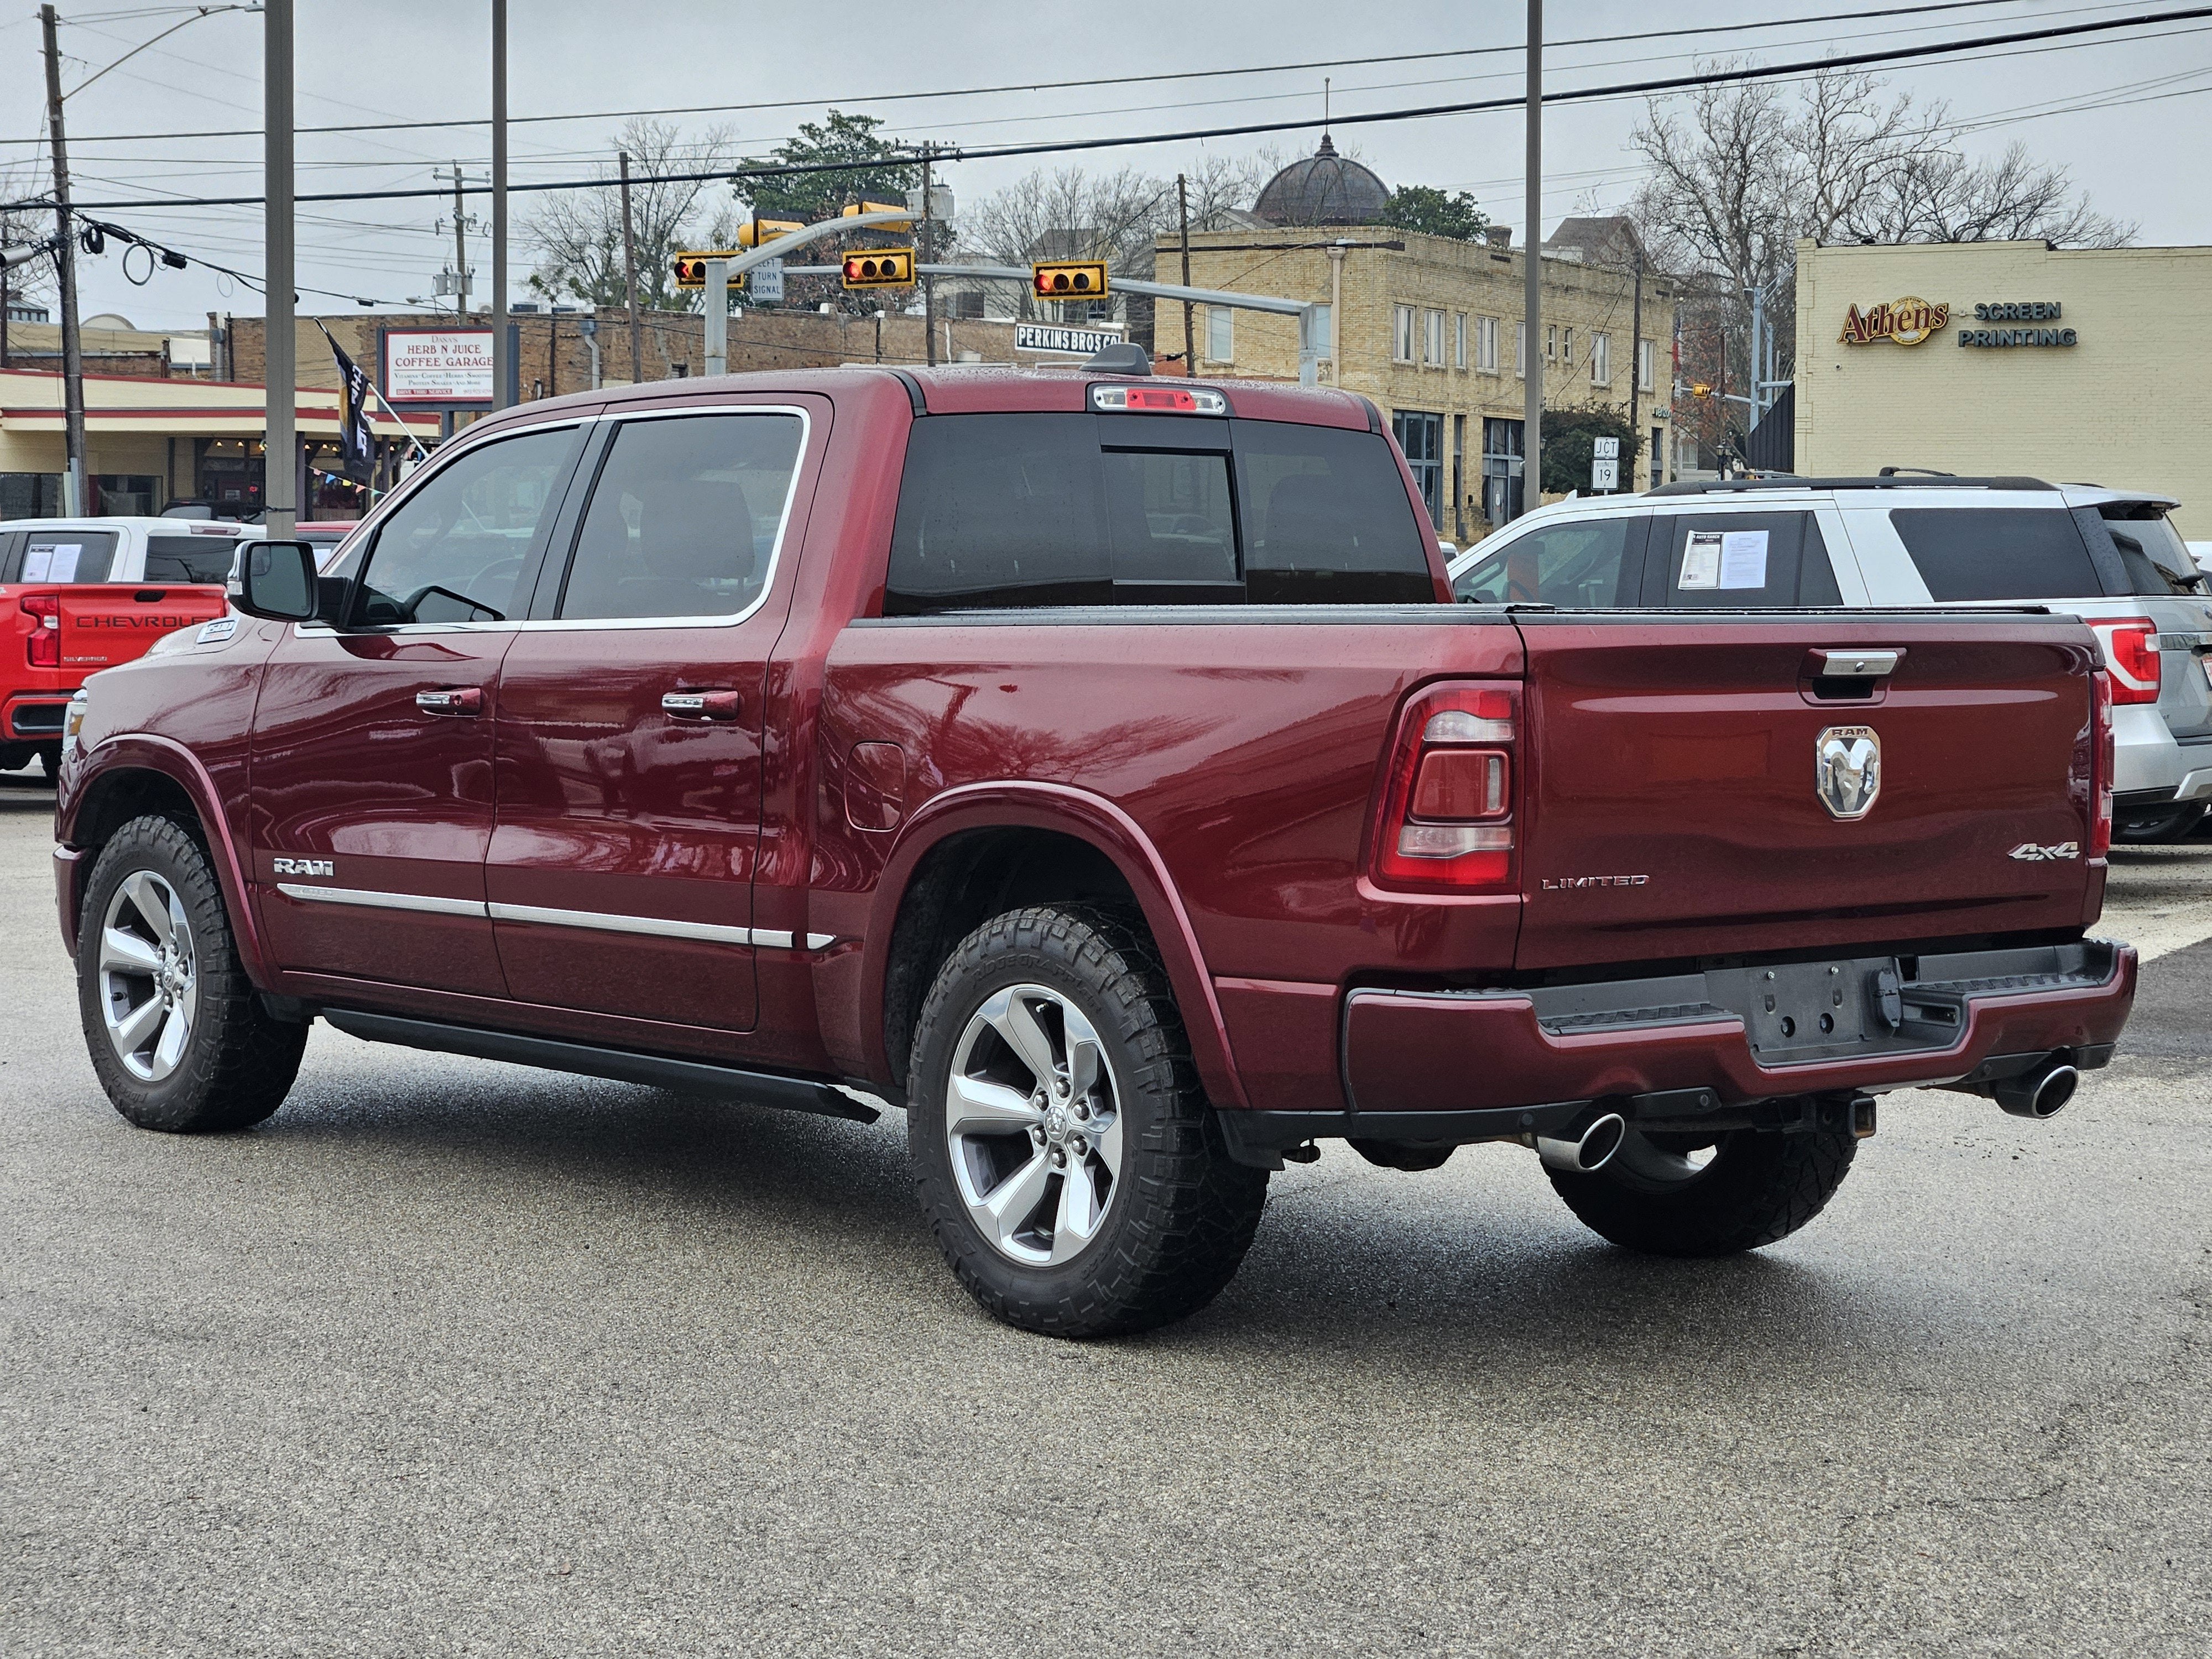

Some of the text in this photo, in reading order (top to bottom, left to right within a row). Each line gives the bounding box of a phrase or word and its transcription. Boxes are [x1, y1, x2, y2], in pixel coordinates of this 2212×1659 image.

[758, 272, 777, 280] TURN
[754, 285, 781, 294] SIGNAL
[1975, 302, 2062, 320] SCREEN
[1837, 302, 1949, 343] Athens
[1018, 327, 1069, 349] PERKINS
[1071, 332, 1102, 352] BROS
[1958, 328, 2078, 348] PRINTING
[408, 344, 482, 354] HERB N JUICE
[395, 357, 493, 367] COFFEE GARAGE
[1597, 441, 1616, 454] JCT
[1600, 469, 1611, 481] 19
[76, 616, 213, 628] CHEVROLE
[274, 858, 334, 876] RAM
[1542, 874, 1650, 890] LIMITED
[971, 954, 1017, 989] RIDGE
